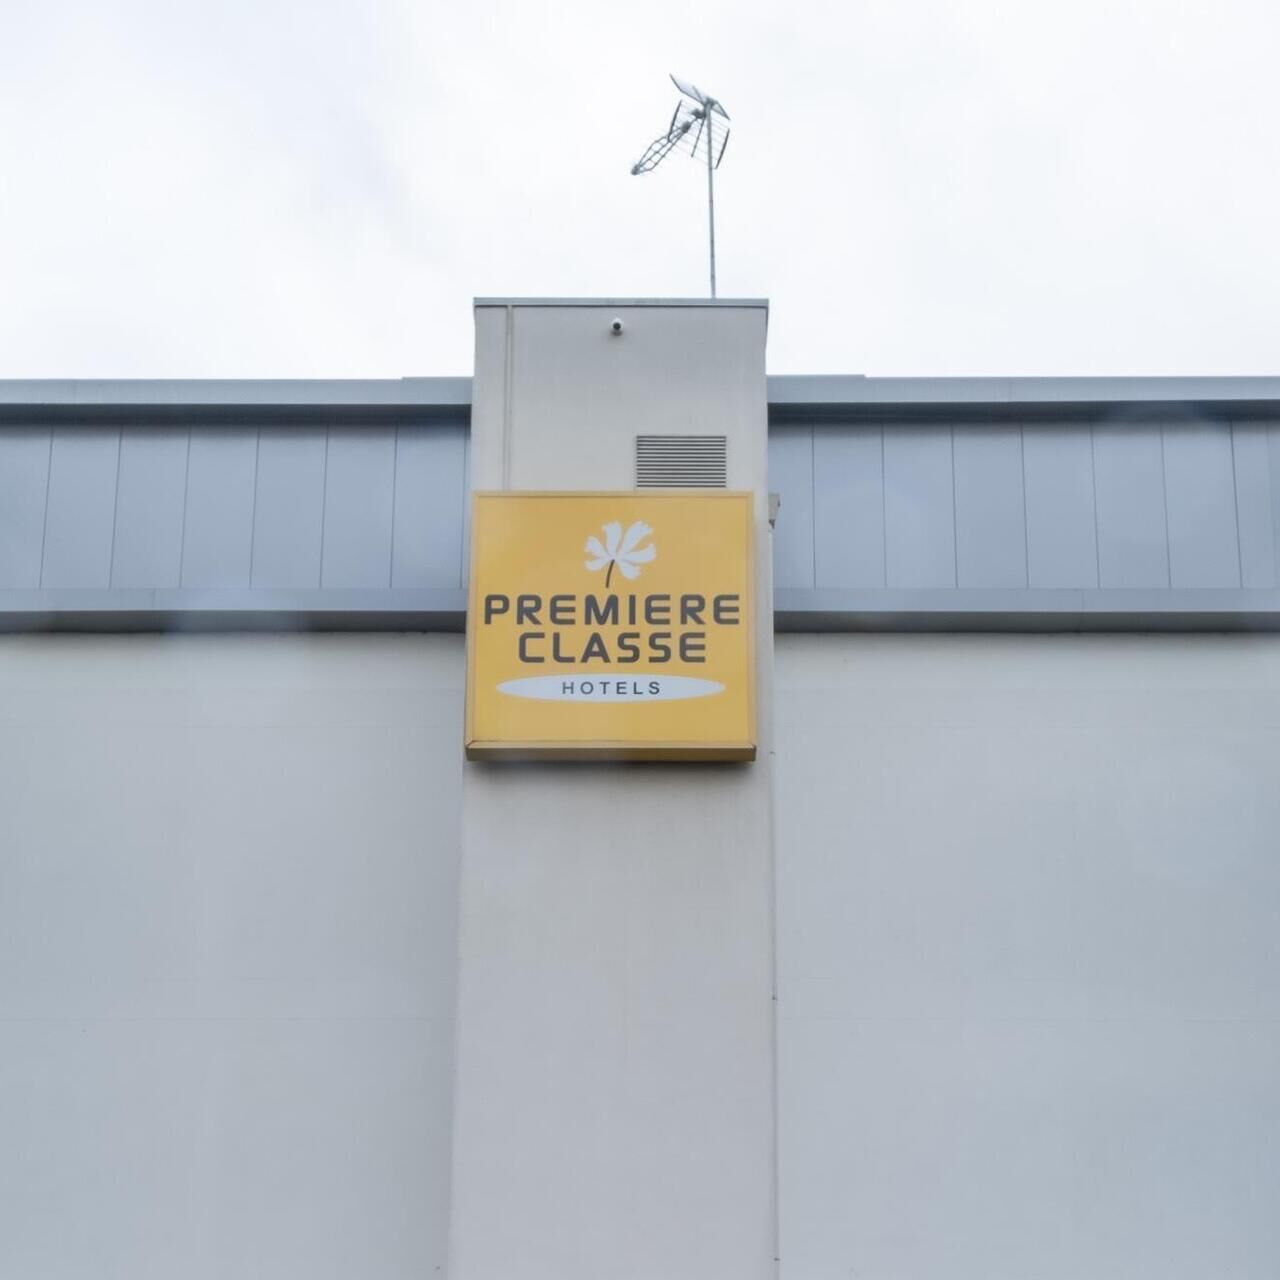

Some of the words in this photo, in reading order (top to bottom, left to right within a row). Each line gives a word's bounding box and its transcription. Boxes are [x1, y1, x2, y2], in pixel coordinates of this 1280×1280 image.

[483, 594, 740, 625] PREMIERE
[518, 632, 706, 663] CLASSE
[562, 681, 660, 695] HOTELS
